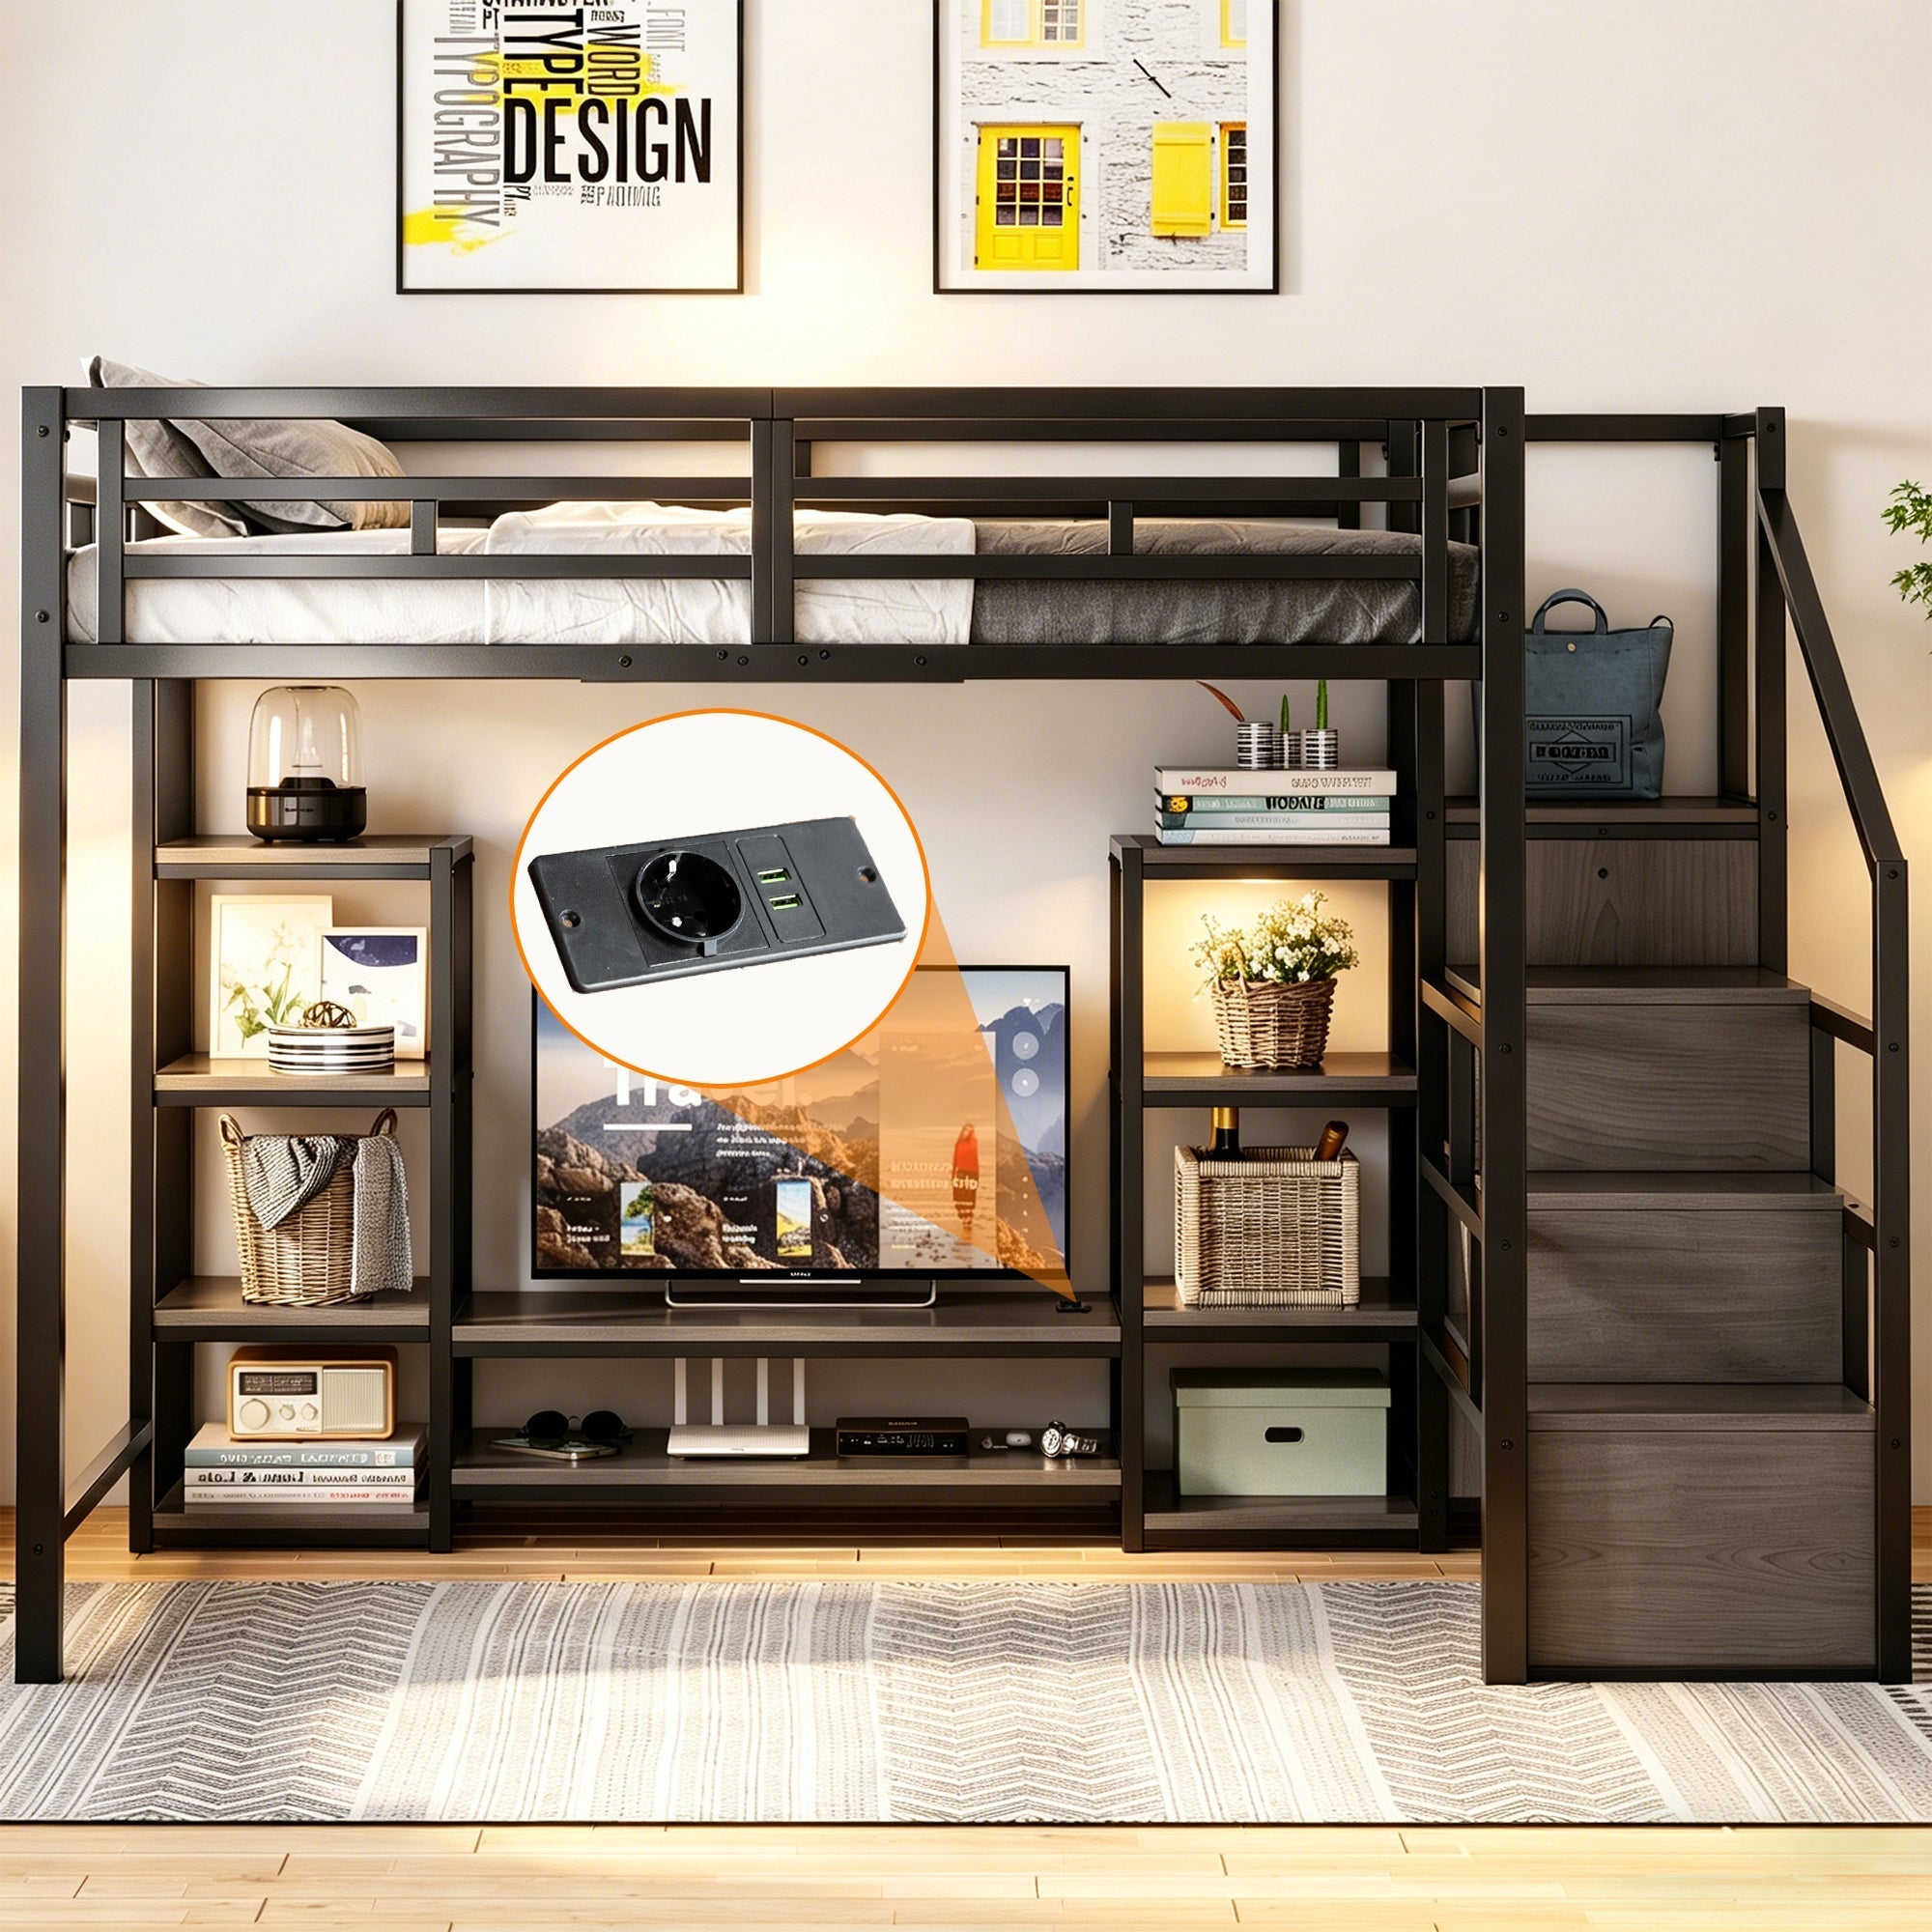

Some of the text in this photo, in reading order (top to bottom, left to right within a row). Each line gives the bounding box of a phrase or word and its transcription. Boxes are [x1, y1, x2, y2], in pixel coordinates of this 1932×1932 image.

[503, 8, 583, 95] TYPE
[587, 24, 641, 96] WORD
[434, 33, 500, 227] TYPOGRAPHY
[503, 98, 712, 184] DESIGN
